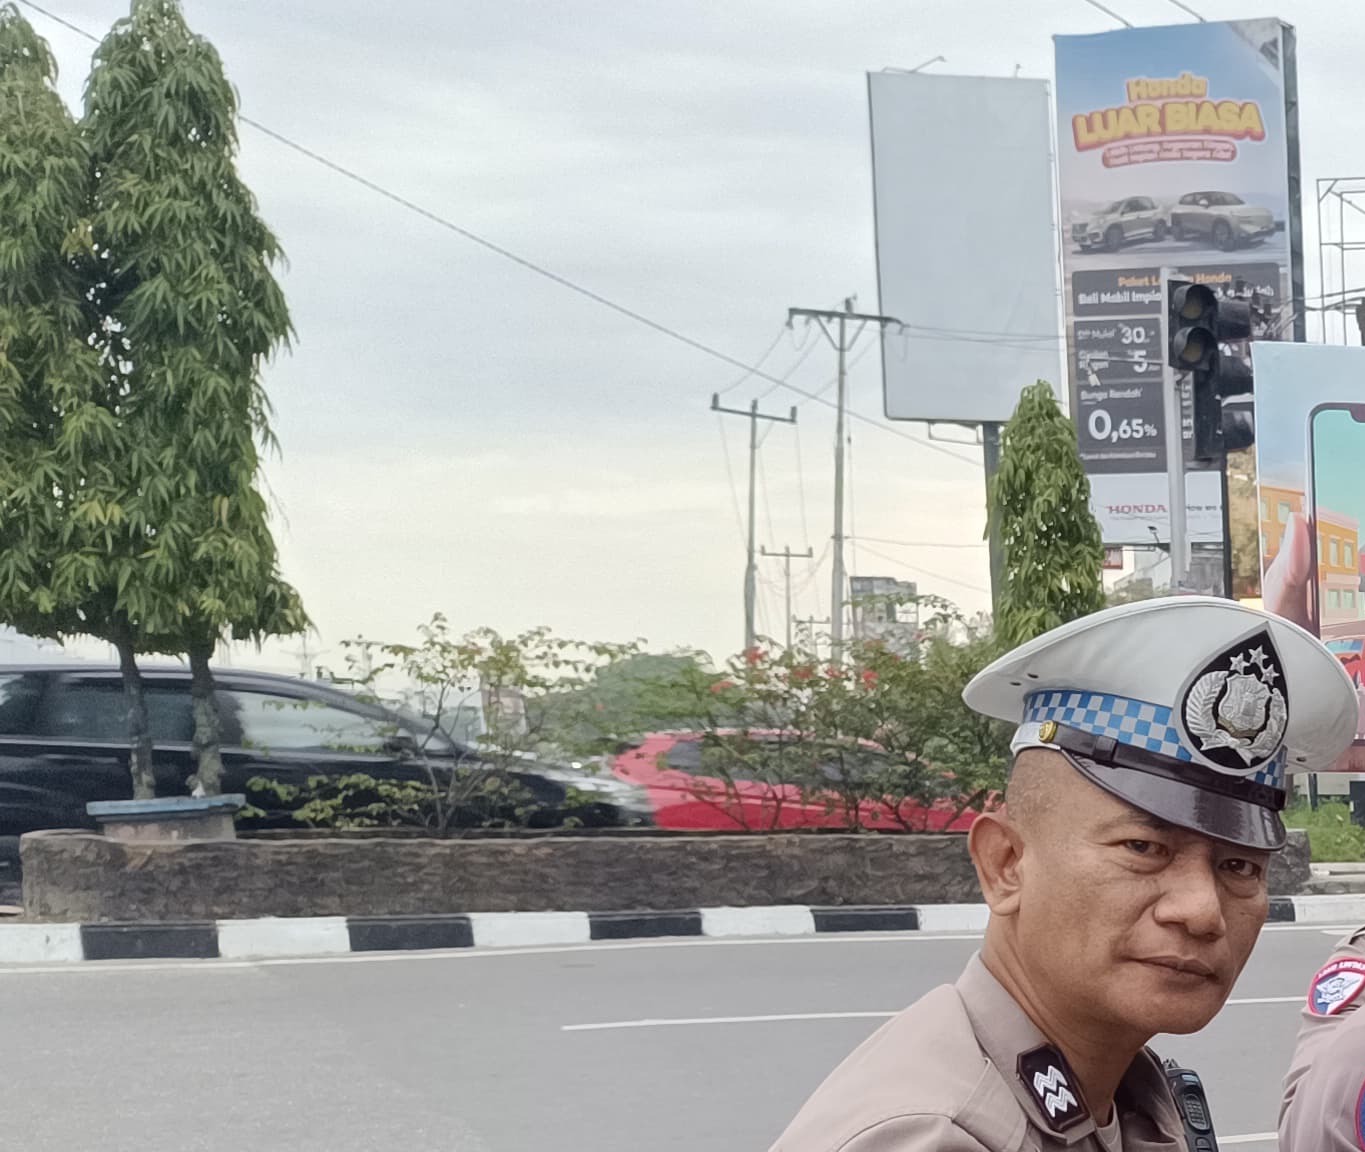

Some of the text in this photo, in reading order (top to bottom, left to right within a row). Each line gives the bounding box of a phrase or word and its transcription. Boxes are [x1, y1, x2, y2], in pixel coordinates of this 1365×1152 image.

[1072, 101, 1266, 150] LUAR BIASA
[1132, 289, 1161, 304] Impia
[1121, 326, 1145, 344] 30
[1088, 409, 1158, 443] 0,65%
